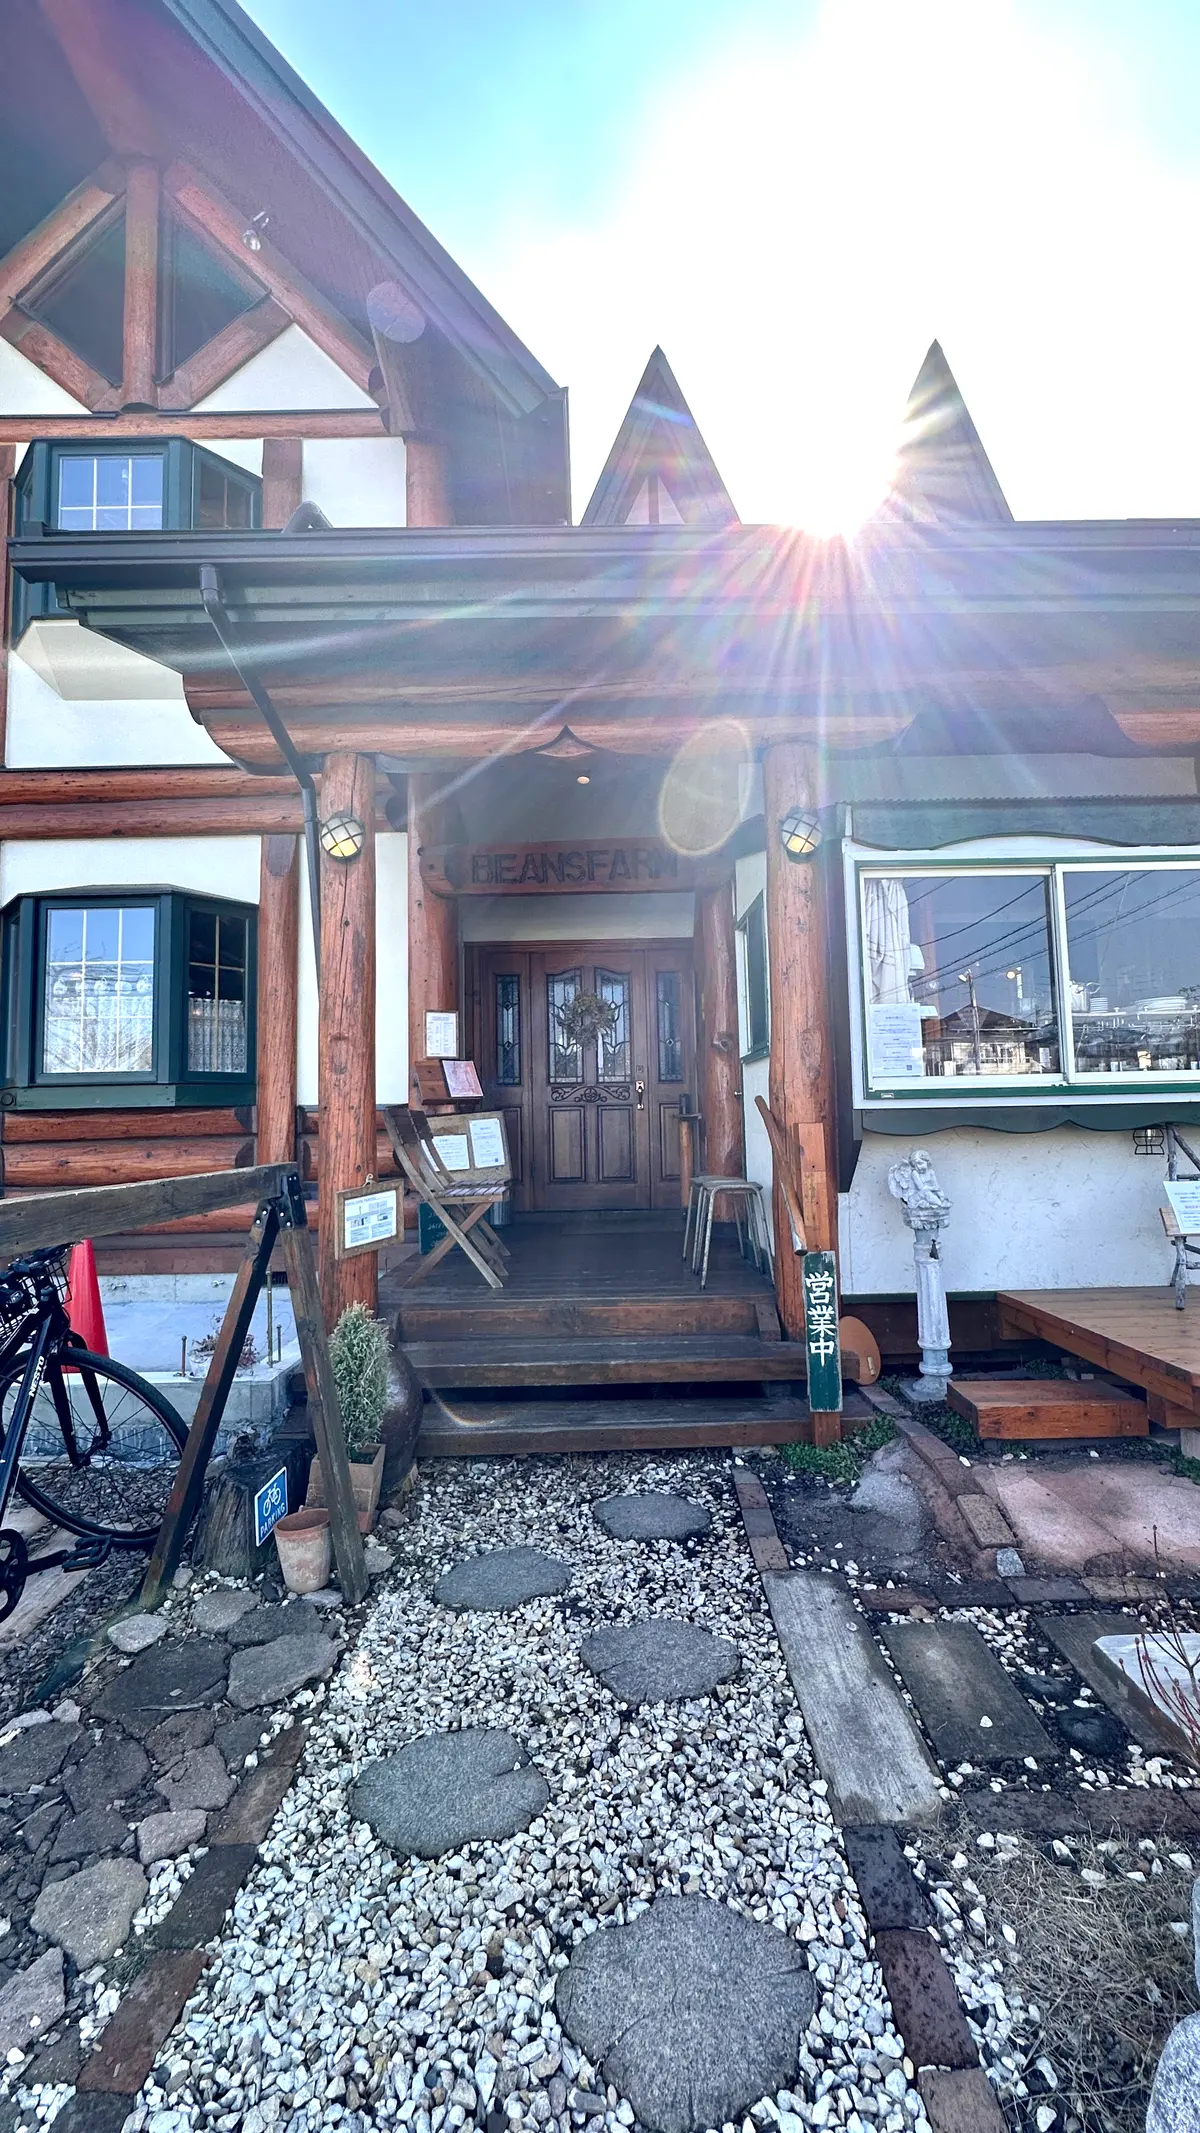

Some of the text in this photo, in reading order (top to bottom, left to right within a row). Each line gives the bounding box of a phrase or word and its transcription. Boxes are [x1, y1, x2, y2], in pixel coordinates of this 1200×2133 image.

[472, 848, 679, 884] BEANSFARM
[805, 1271, 836, 1367] 営業中
[29, 1355, 45, 1397] NESTO
[260, 1502, 285, 1538] PARKING
